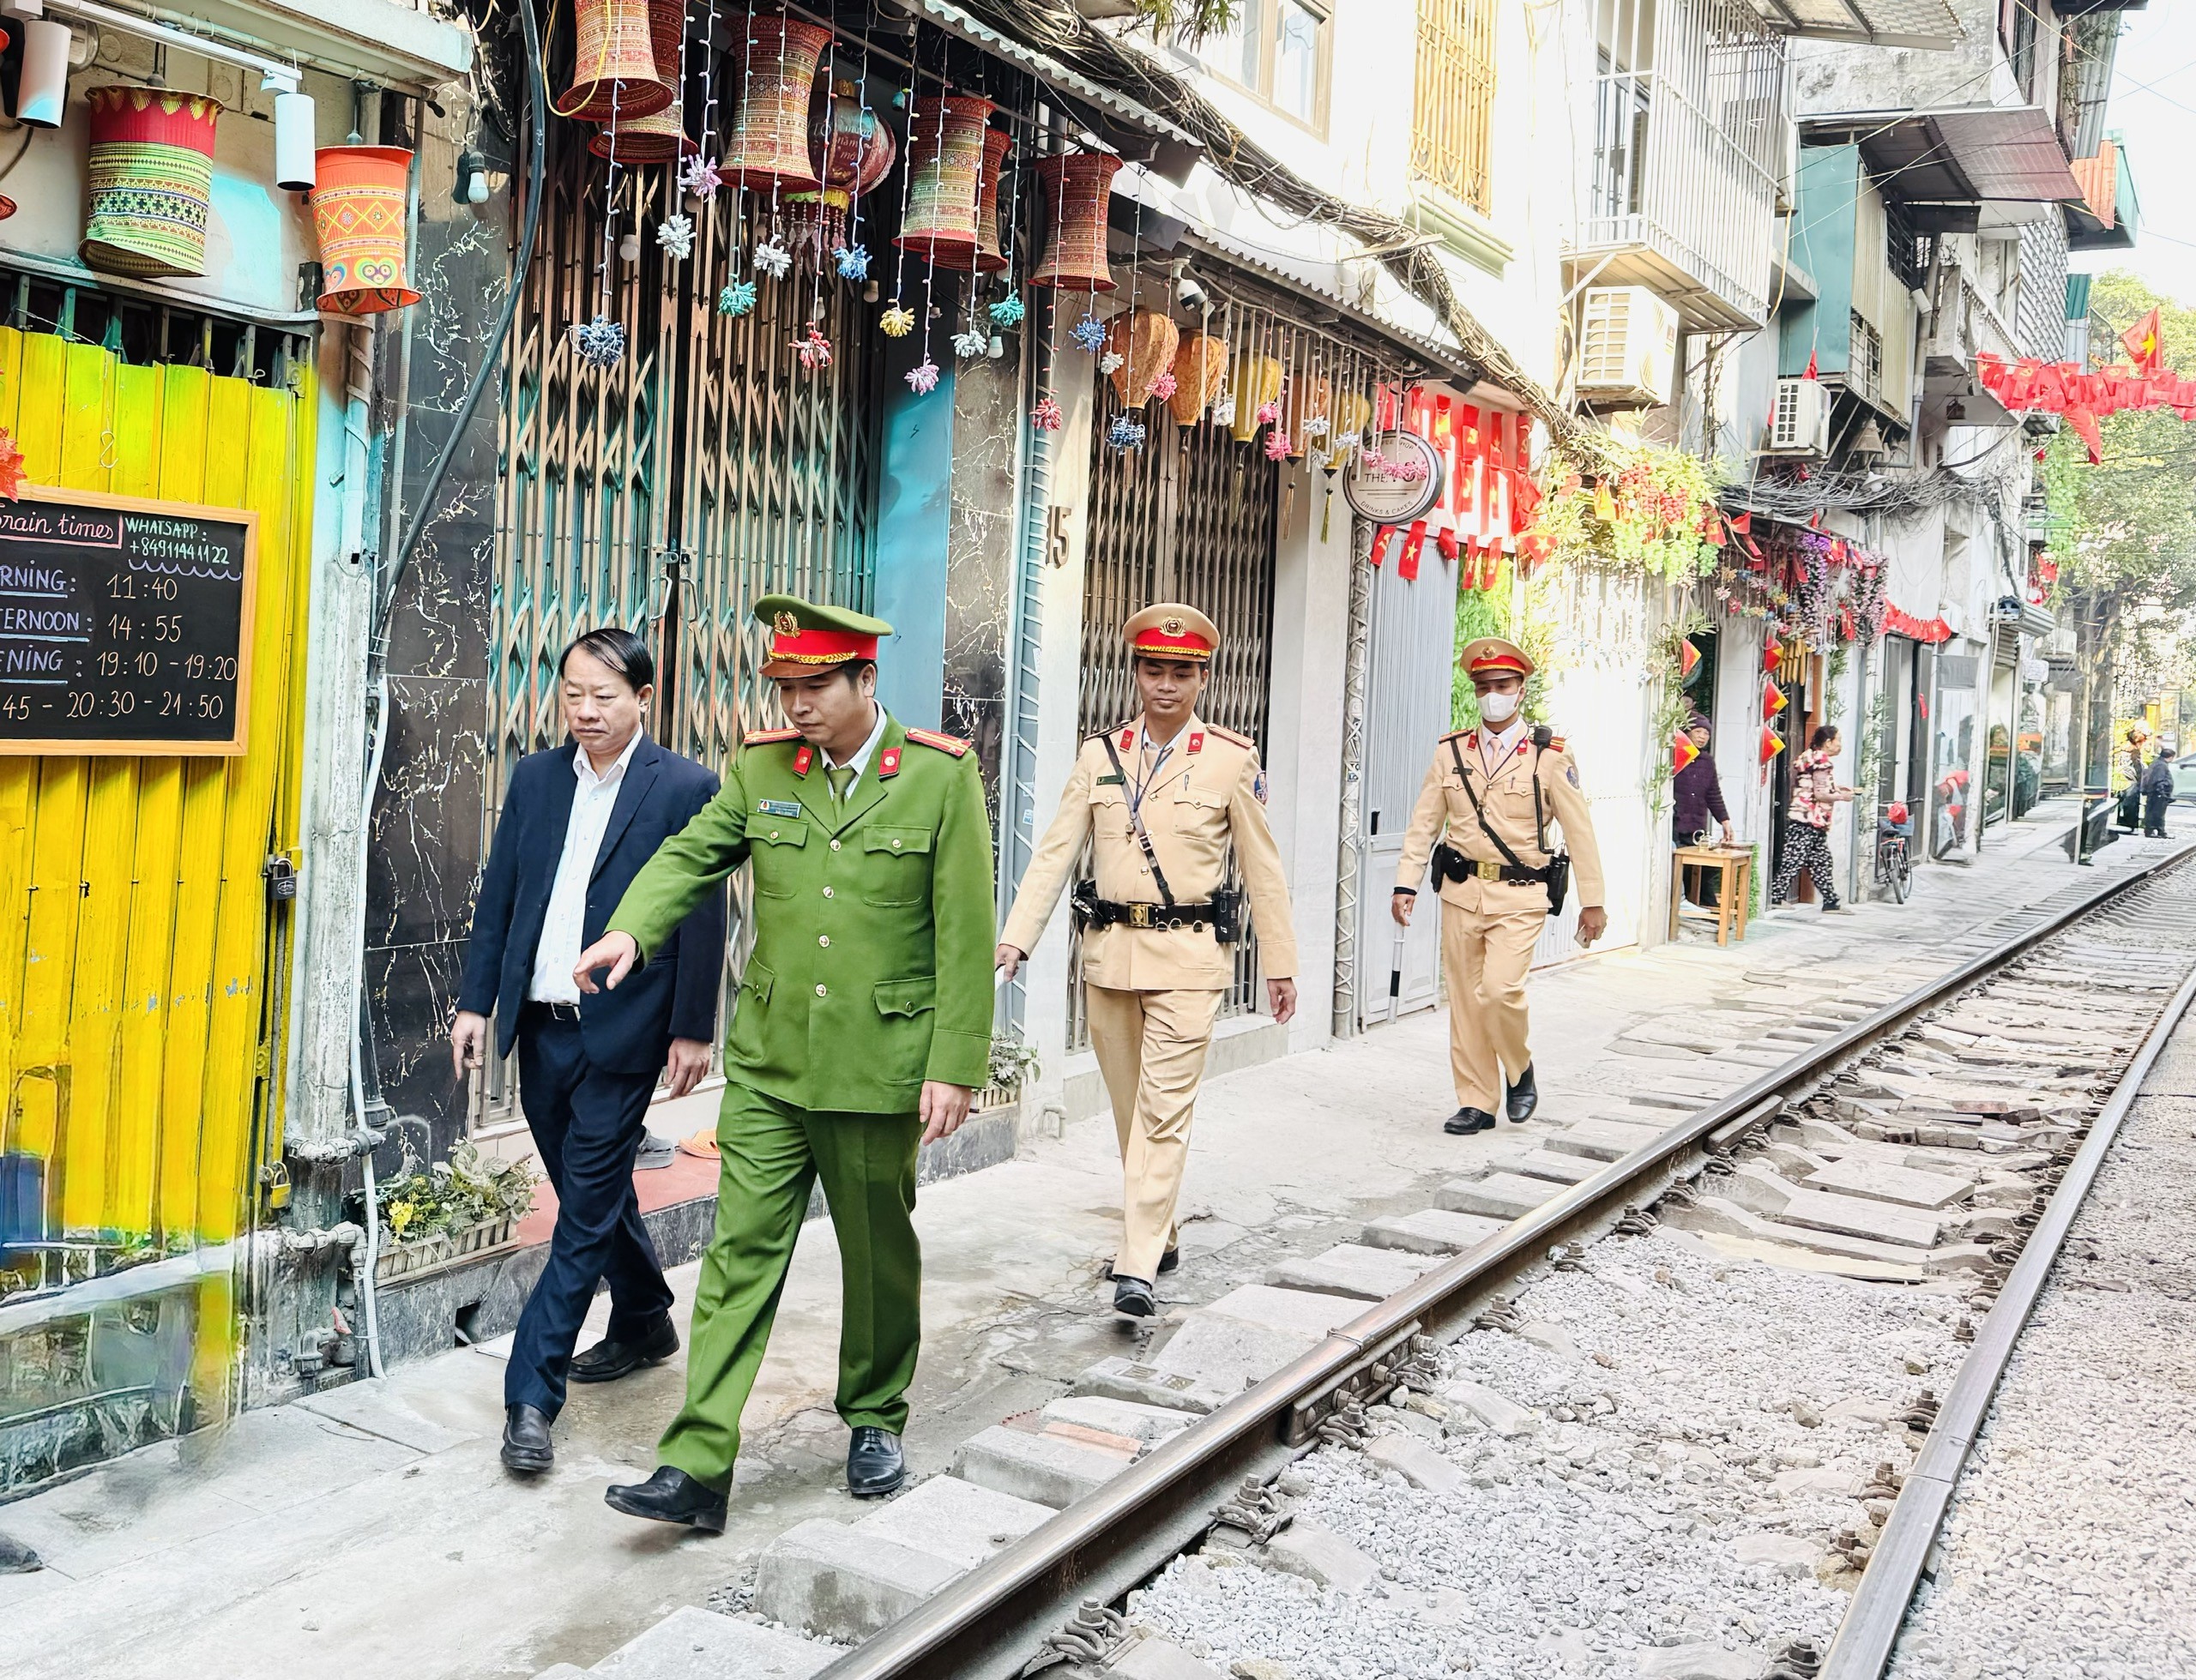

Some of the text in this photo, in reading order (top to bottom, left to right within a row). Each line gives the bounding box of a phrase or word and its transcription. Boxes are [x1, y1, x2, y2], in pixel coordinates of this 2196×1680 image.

[1360, 501, 1383, 515] DRINKS
[1391, 501, 1414, 514] CAKES
[57, 514, 114, 539] times
[106, 573, 178, 600] 11:40
[96, 651, 158, 677] 19:10
[184, 653, 238, 681] 19:20
[66, 690, 136, 719] 20:30
